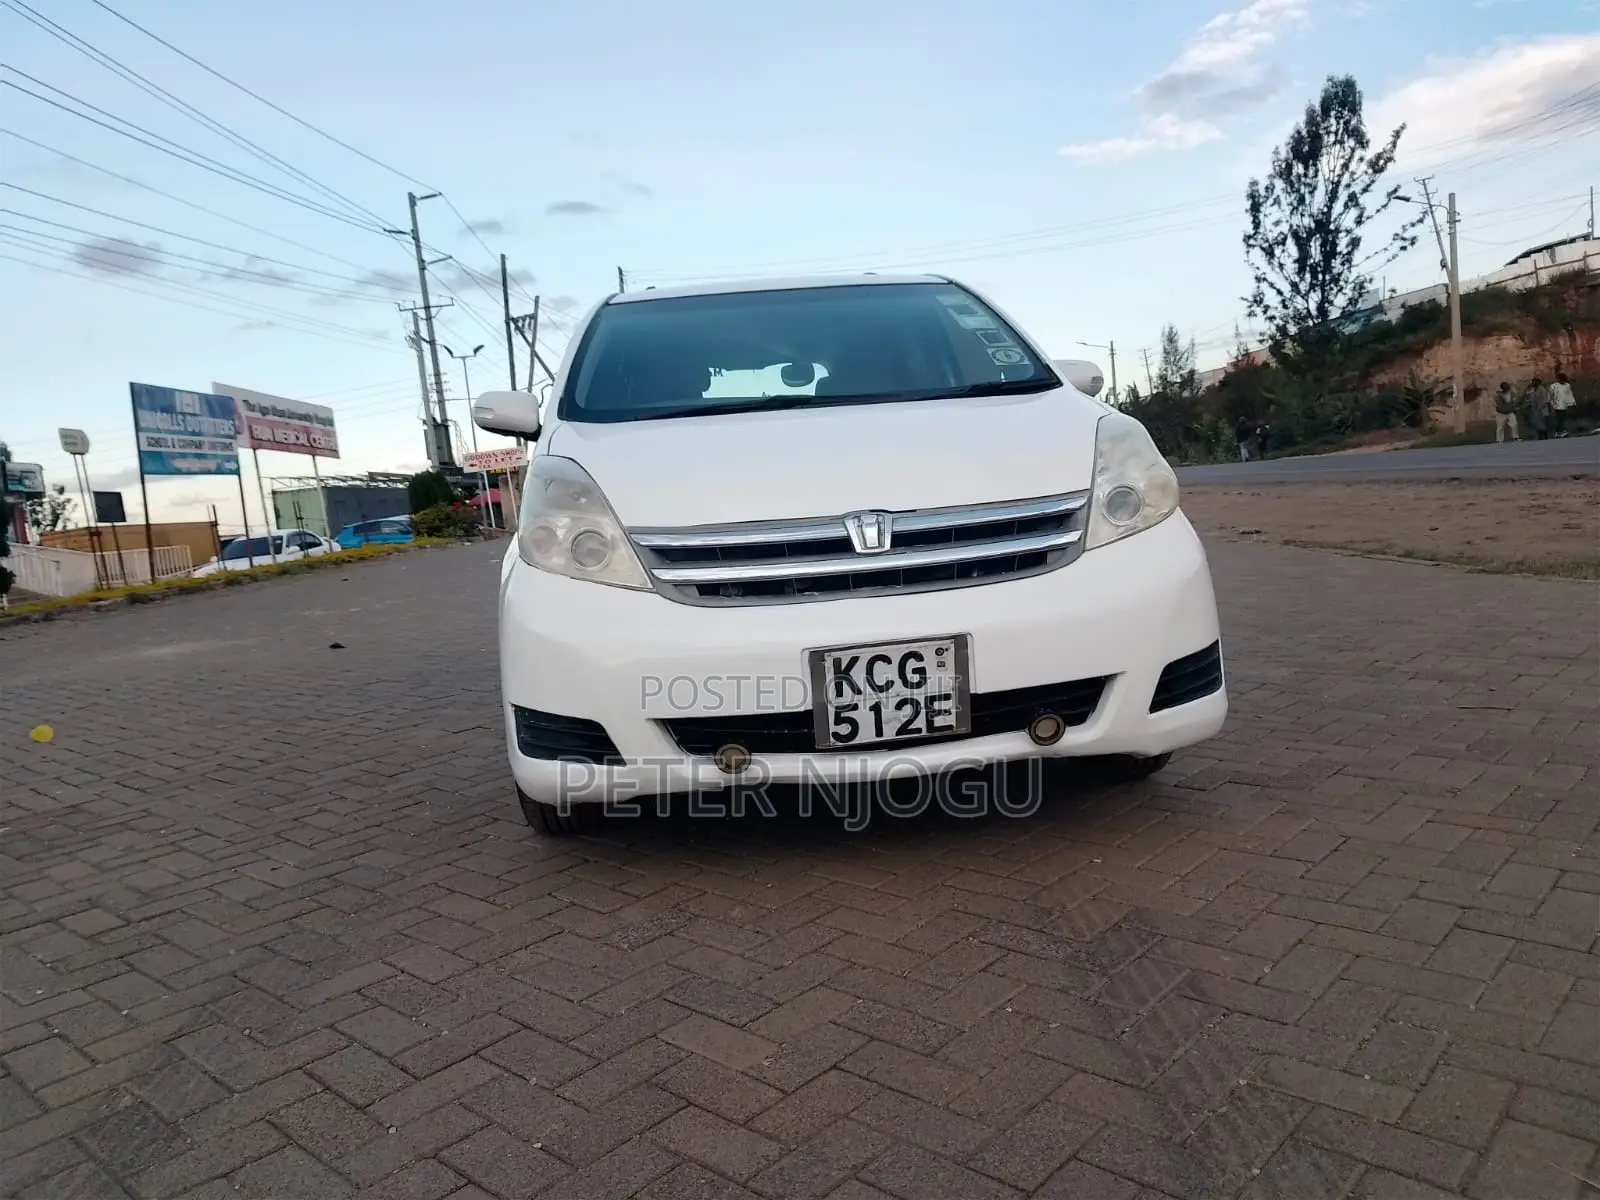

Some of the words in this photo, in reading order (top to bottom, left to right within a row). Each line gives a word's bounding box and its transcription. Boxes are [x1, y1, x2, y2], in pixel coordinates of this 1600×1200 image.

[464, 451, 498, 462] GODOWN
[832, 650, 928, 697] KCG
[831, 693, 955, 743] 512E
